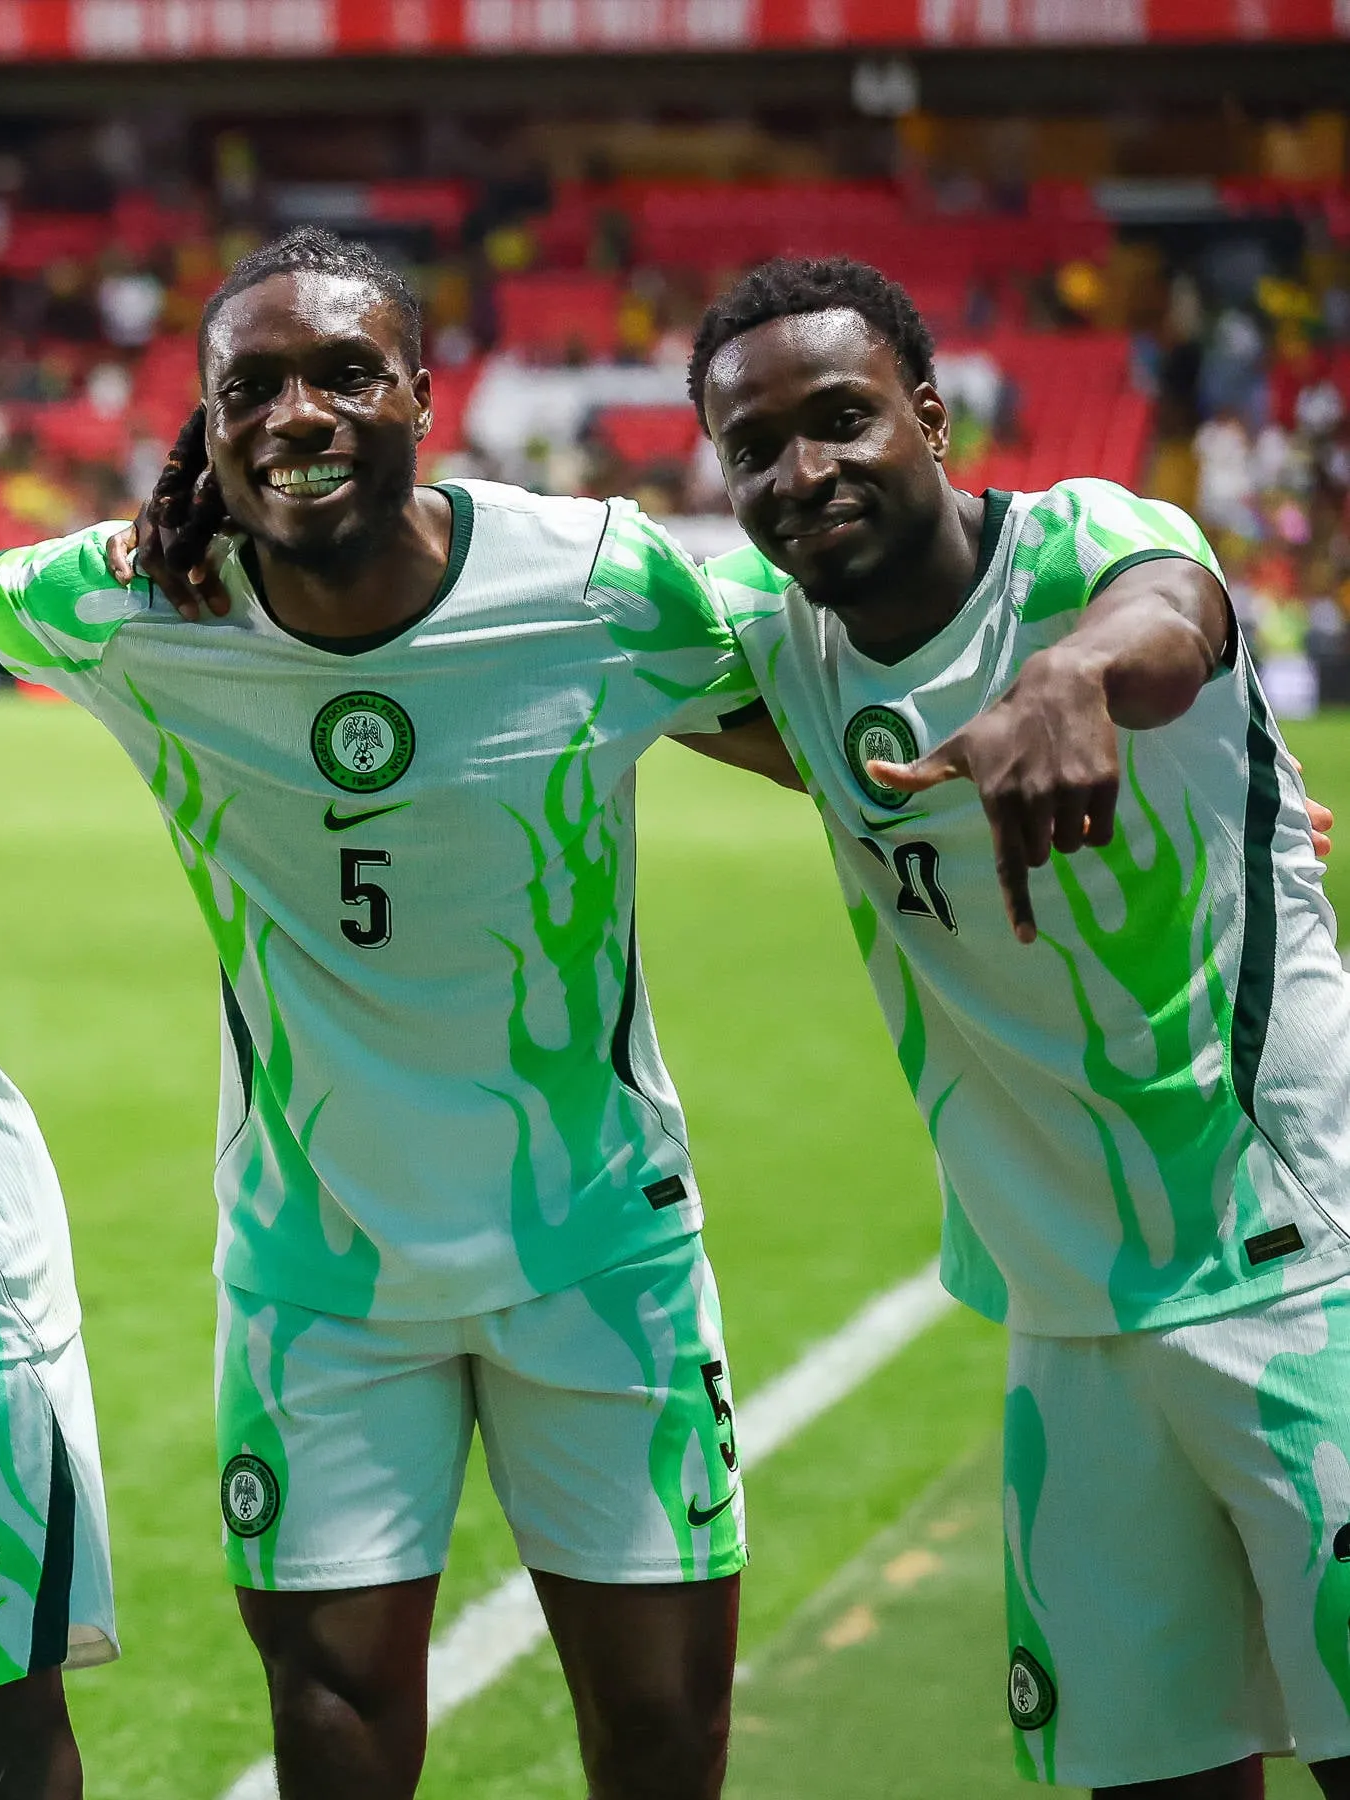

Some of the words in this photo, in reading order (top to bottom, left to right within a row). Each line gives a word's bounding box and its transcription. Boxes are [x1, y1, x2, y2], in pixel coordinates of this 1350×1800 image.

[322, 698, 378, 725] FOOTBALL
[380, 704, 408, 772] FEDERATION
[317, 727, 336, 773] NIGERIA
[340, 848, 392, 949] 5
[700, 1360, 738, 1472] 5
